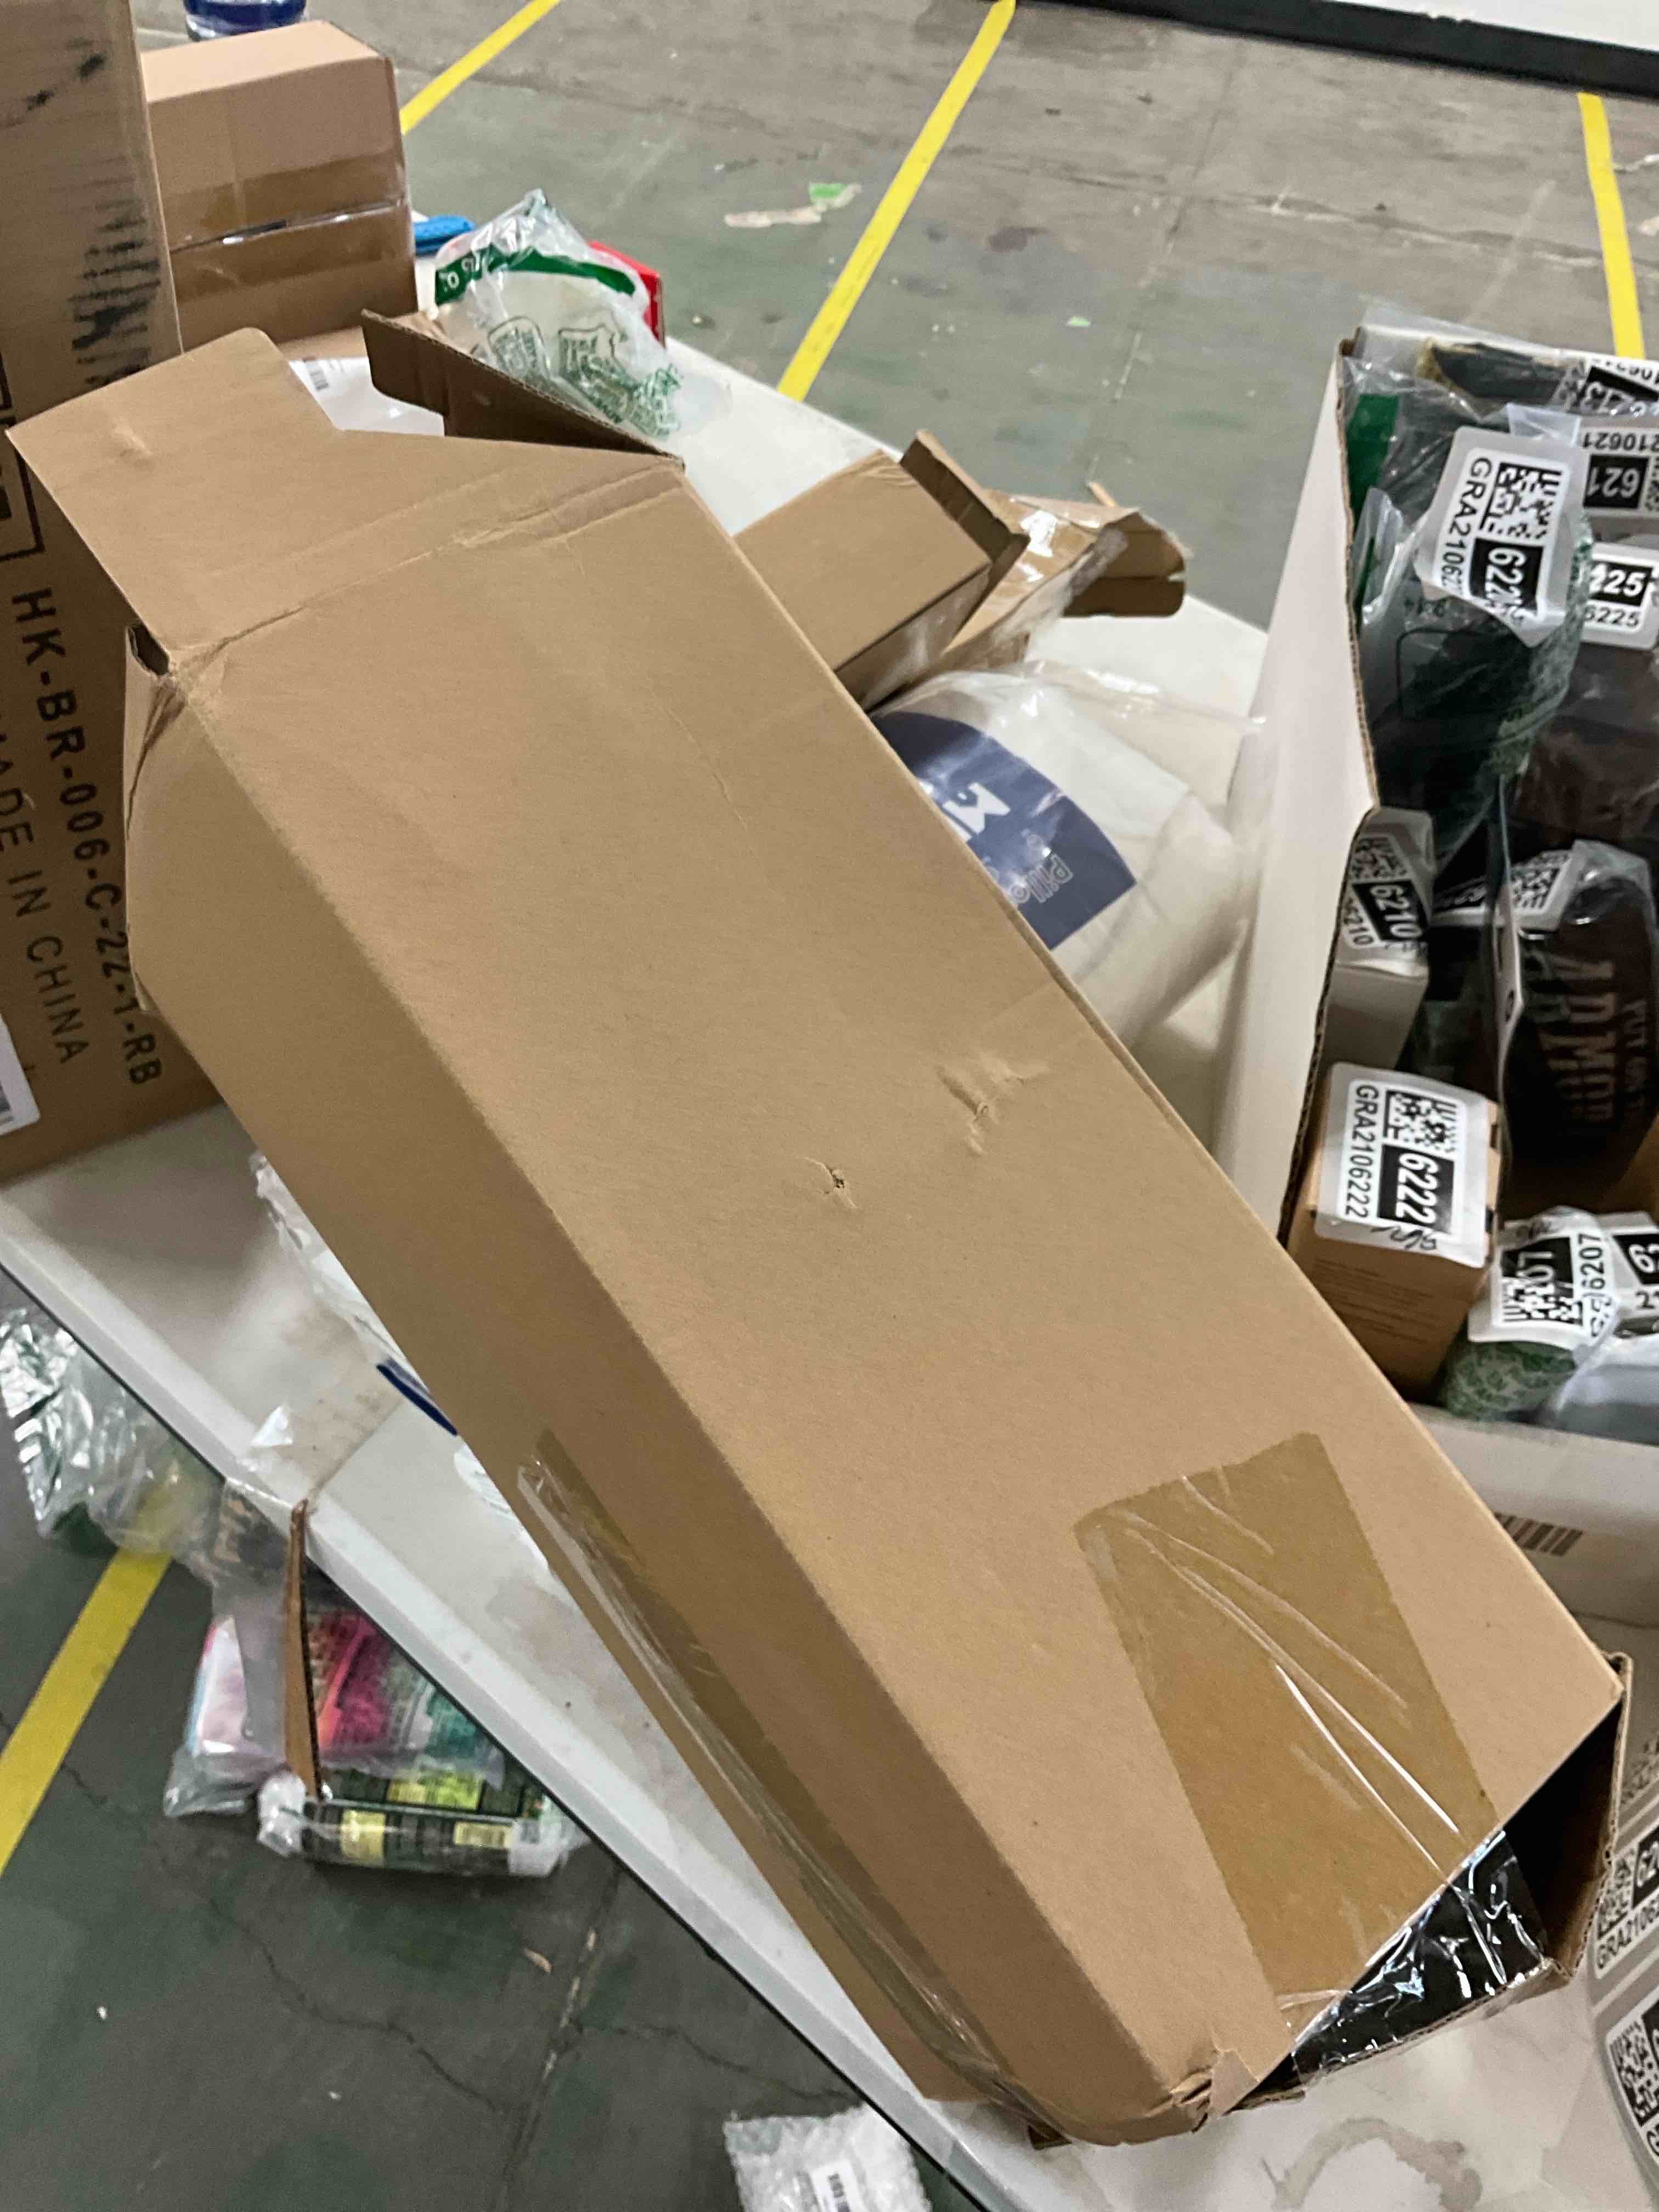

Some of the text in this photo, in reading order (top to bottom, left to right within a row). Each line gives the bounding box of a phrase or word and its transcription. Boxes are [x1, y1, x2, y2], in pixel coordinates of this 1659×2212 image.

[1588, 467, 1640, 498] 621
[8, 870, 52, 918] IN
[1371, 884, 1423, 940] 6210
[26, 935, 90, 1064] CHINA
[1345, 1084, 1380, 1219] GRA2106222
[1395, 1152, 1440, 1225] 6222
